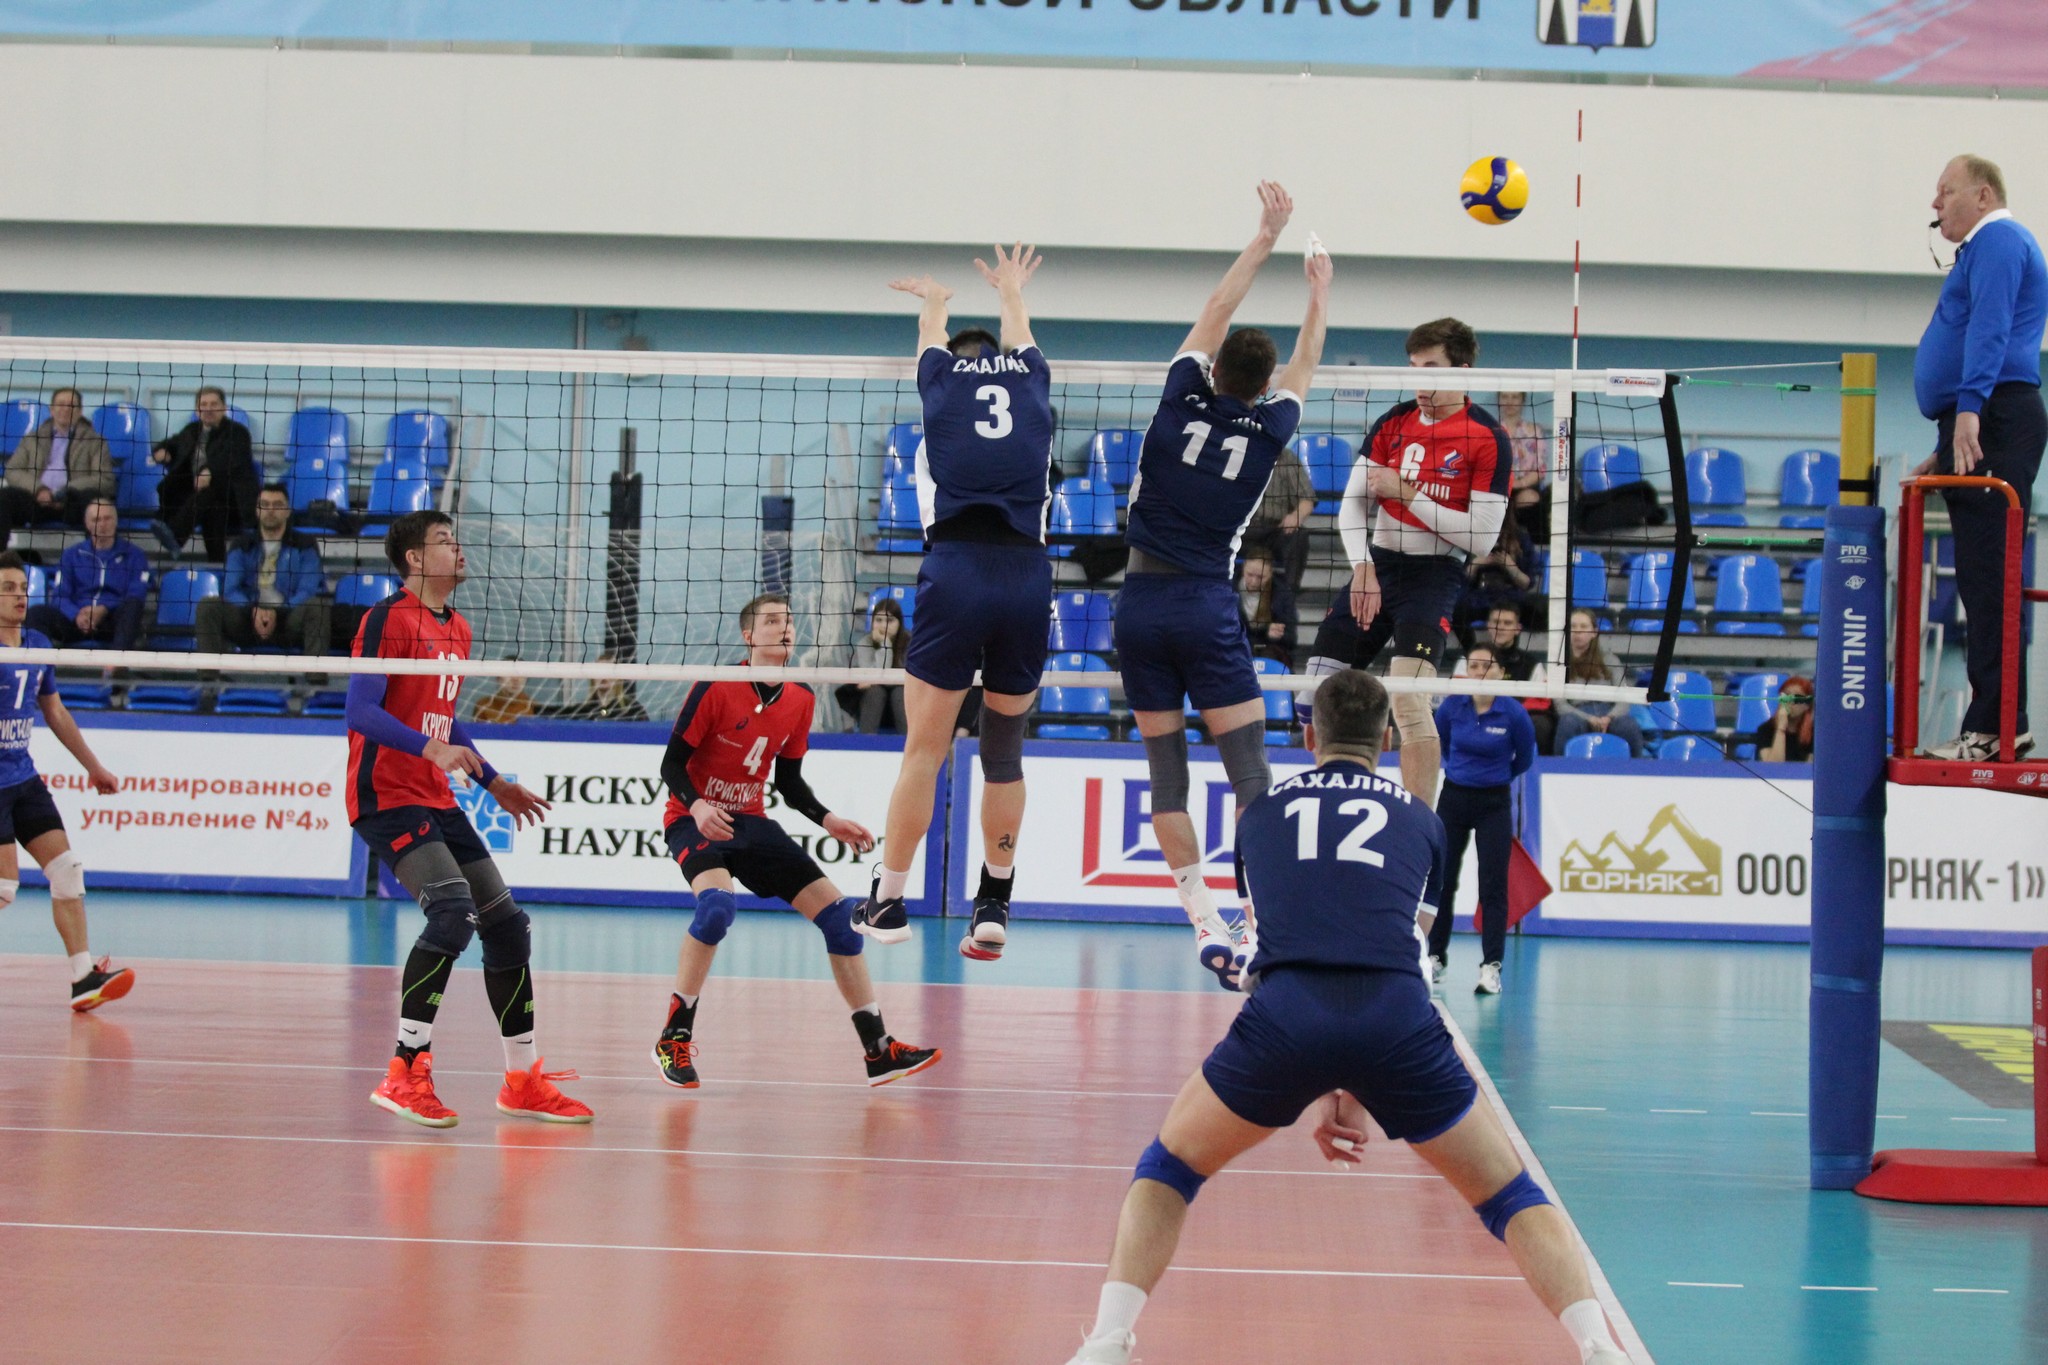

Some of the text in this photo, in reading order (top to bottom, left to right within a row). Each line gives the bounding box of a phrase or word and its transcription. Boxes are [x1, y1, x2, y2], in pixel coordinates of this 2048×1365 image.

[975, 384, 1013, 439] 3
[1182, 420, 1249, 480] 11
[1841, 545, 1867, 556] FIVB
[437, 650, 460, 702] 13
[1841, 607, 1867, 710] JINLING
[14, 669, 29, 709] 7
[743, 736, 769, 776] 4
[1972, 769, 1994, 778] FIVB
[40, 773, 332, 800] ецлизированное
[1267, 772, 1412, 805] САХАЛИН
[80, 808, 257, 831] управление
[1284, 797, 1389, 869] 12
[1562, 870, 1721, 894] ГОРНЯК-1
[1887, 857, 2046, 902] РНЯК-1»
